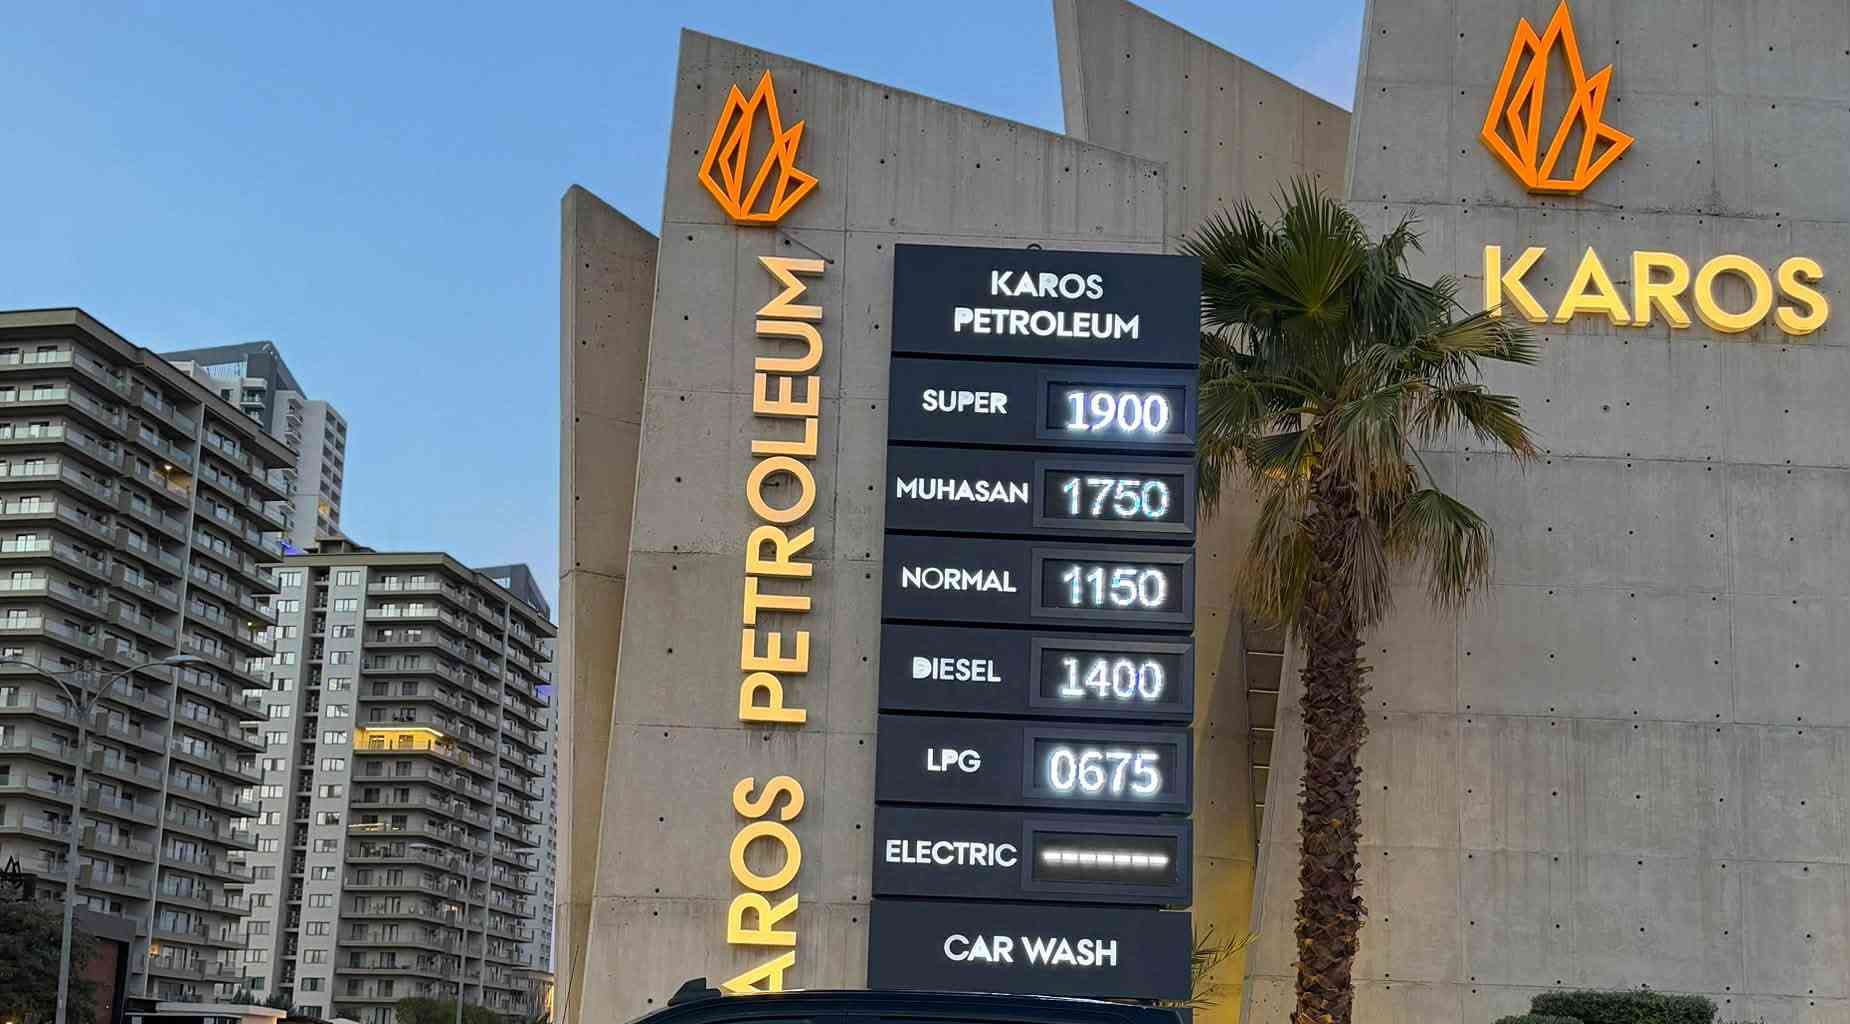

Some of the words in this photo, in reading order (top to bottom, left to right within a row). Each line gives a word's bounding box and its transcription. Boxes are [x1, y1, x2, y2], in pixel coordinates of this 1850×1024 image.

[990, 270, 1105, 300] KAROS
[1482, 245, 1830, 335] KAROS
[953, 307, 1140, 340] PETROLEUM
[922, 388, 1008, 415] SUPER
[1066, 391, 1170, 435] 1900
[738, 255, 825, 724] PETROLEUM
[896, 476, 1029, 504] MUHASAN
[1063, 476, 1170, 519] 1750
[901, 566, 1017, 593] NORMAL
[1063, 565, 1168, 608] 1150
[912, 656, 1002, 683] DIESEL
[1060, 656, 1165, 700] 1400
[927, 748, 982, 773] LPG
[1048, 747, 1162, 796] 0675
[885, 839, 1018, 867] ELECTRIC
[943, 934, 1014, 964] CAR
[1020, 937, 1118, 967] WASH
